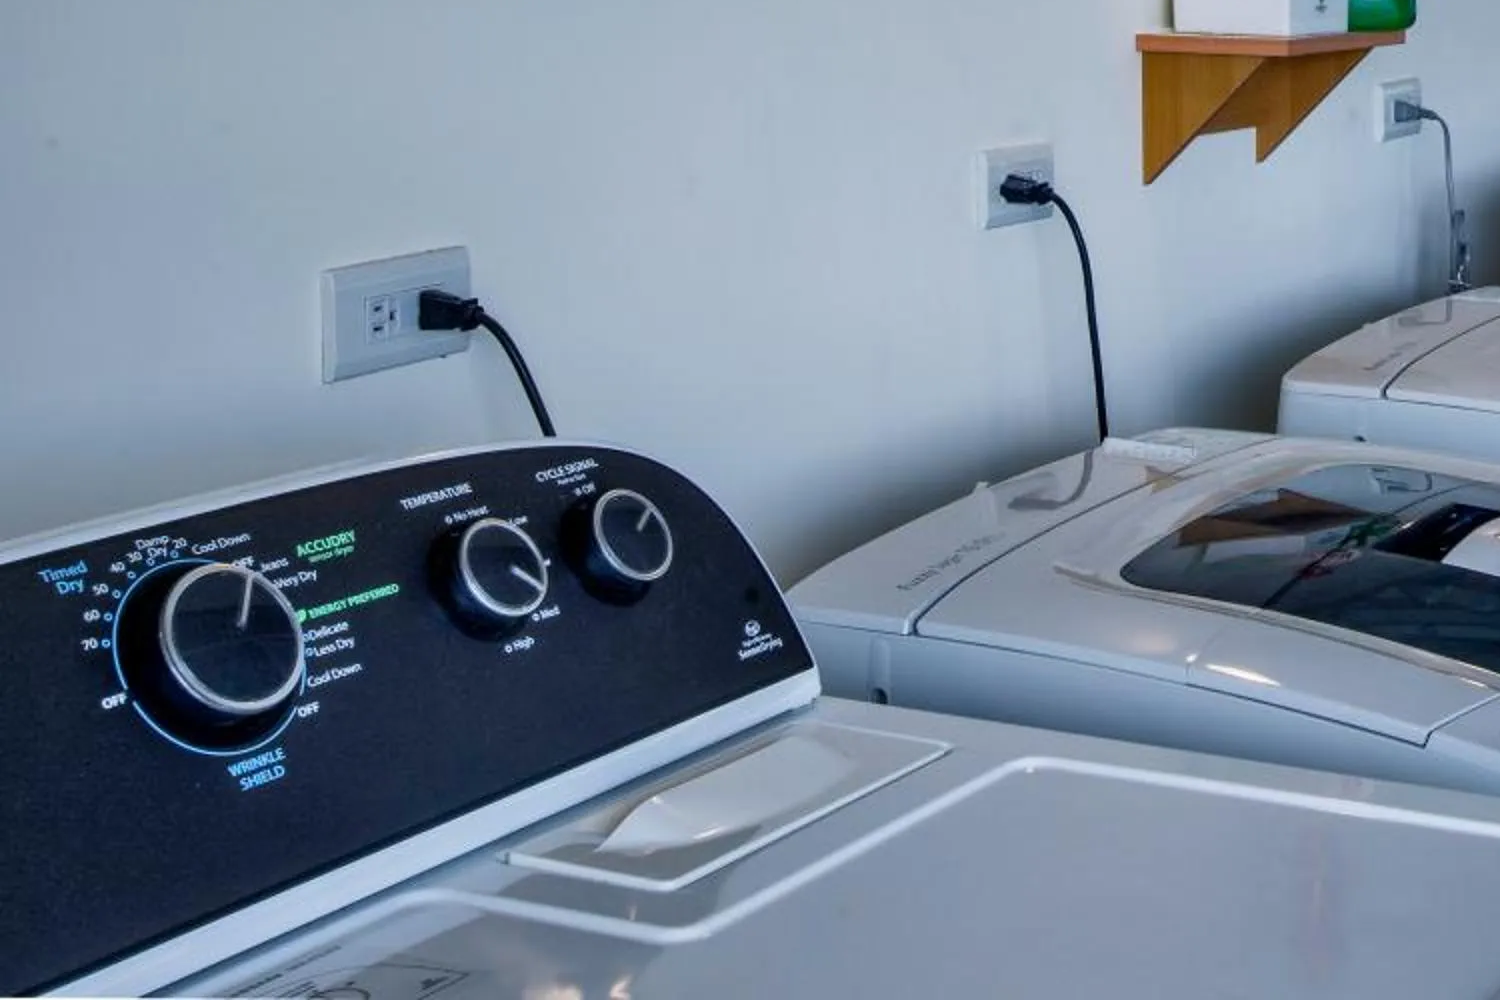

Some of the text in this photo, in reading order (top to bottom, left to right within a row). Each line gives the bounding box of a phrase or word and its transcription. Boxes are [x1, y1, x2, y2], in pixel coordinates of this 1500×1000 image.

[400, 482, 473, 510] TEMPERATURE
[134, 536, 169, 551] Damp
[172, 537, 188, 550] 20
[191, 533, 251, 555] Cool Down
[296, 530, 356, 557] ACCUDRY
[147, 546, 168, 558] Dry
[37, 560, 88, 582] Timed
[299, 569, 318, 582] Dry
[56, 580, 84, 595] Dry
[92, 583, 109, 596] 50
[83, 609, 101, 623] 60
[81, 637, 99, 650] 70
[336, 637, 355, 649] Dry
[307, 663, 362, 687] Cool Down
[101, 692, 127, 709] OFF
[298, 701, 320, 717] OFF
[227, 747, 287, 777] WRINKLE
[239, 765, 285, 791] SHIELD
